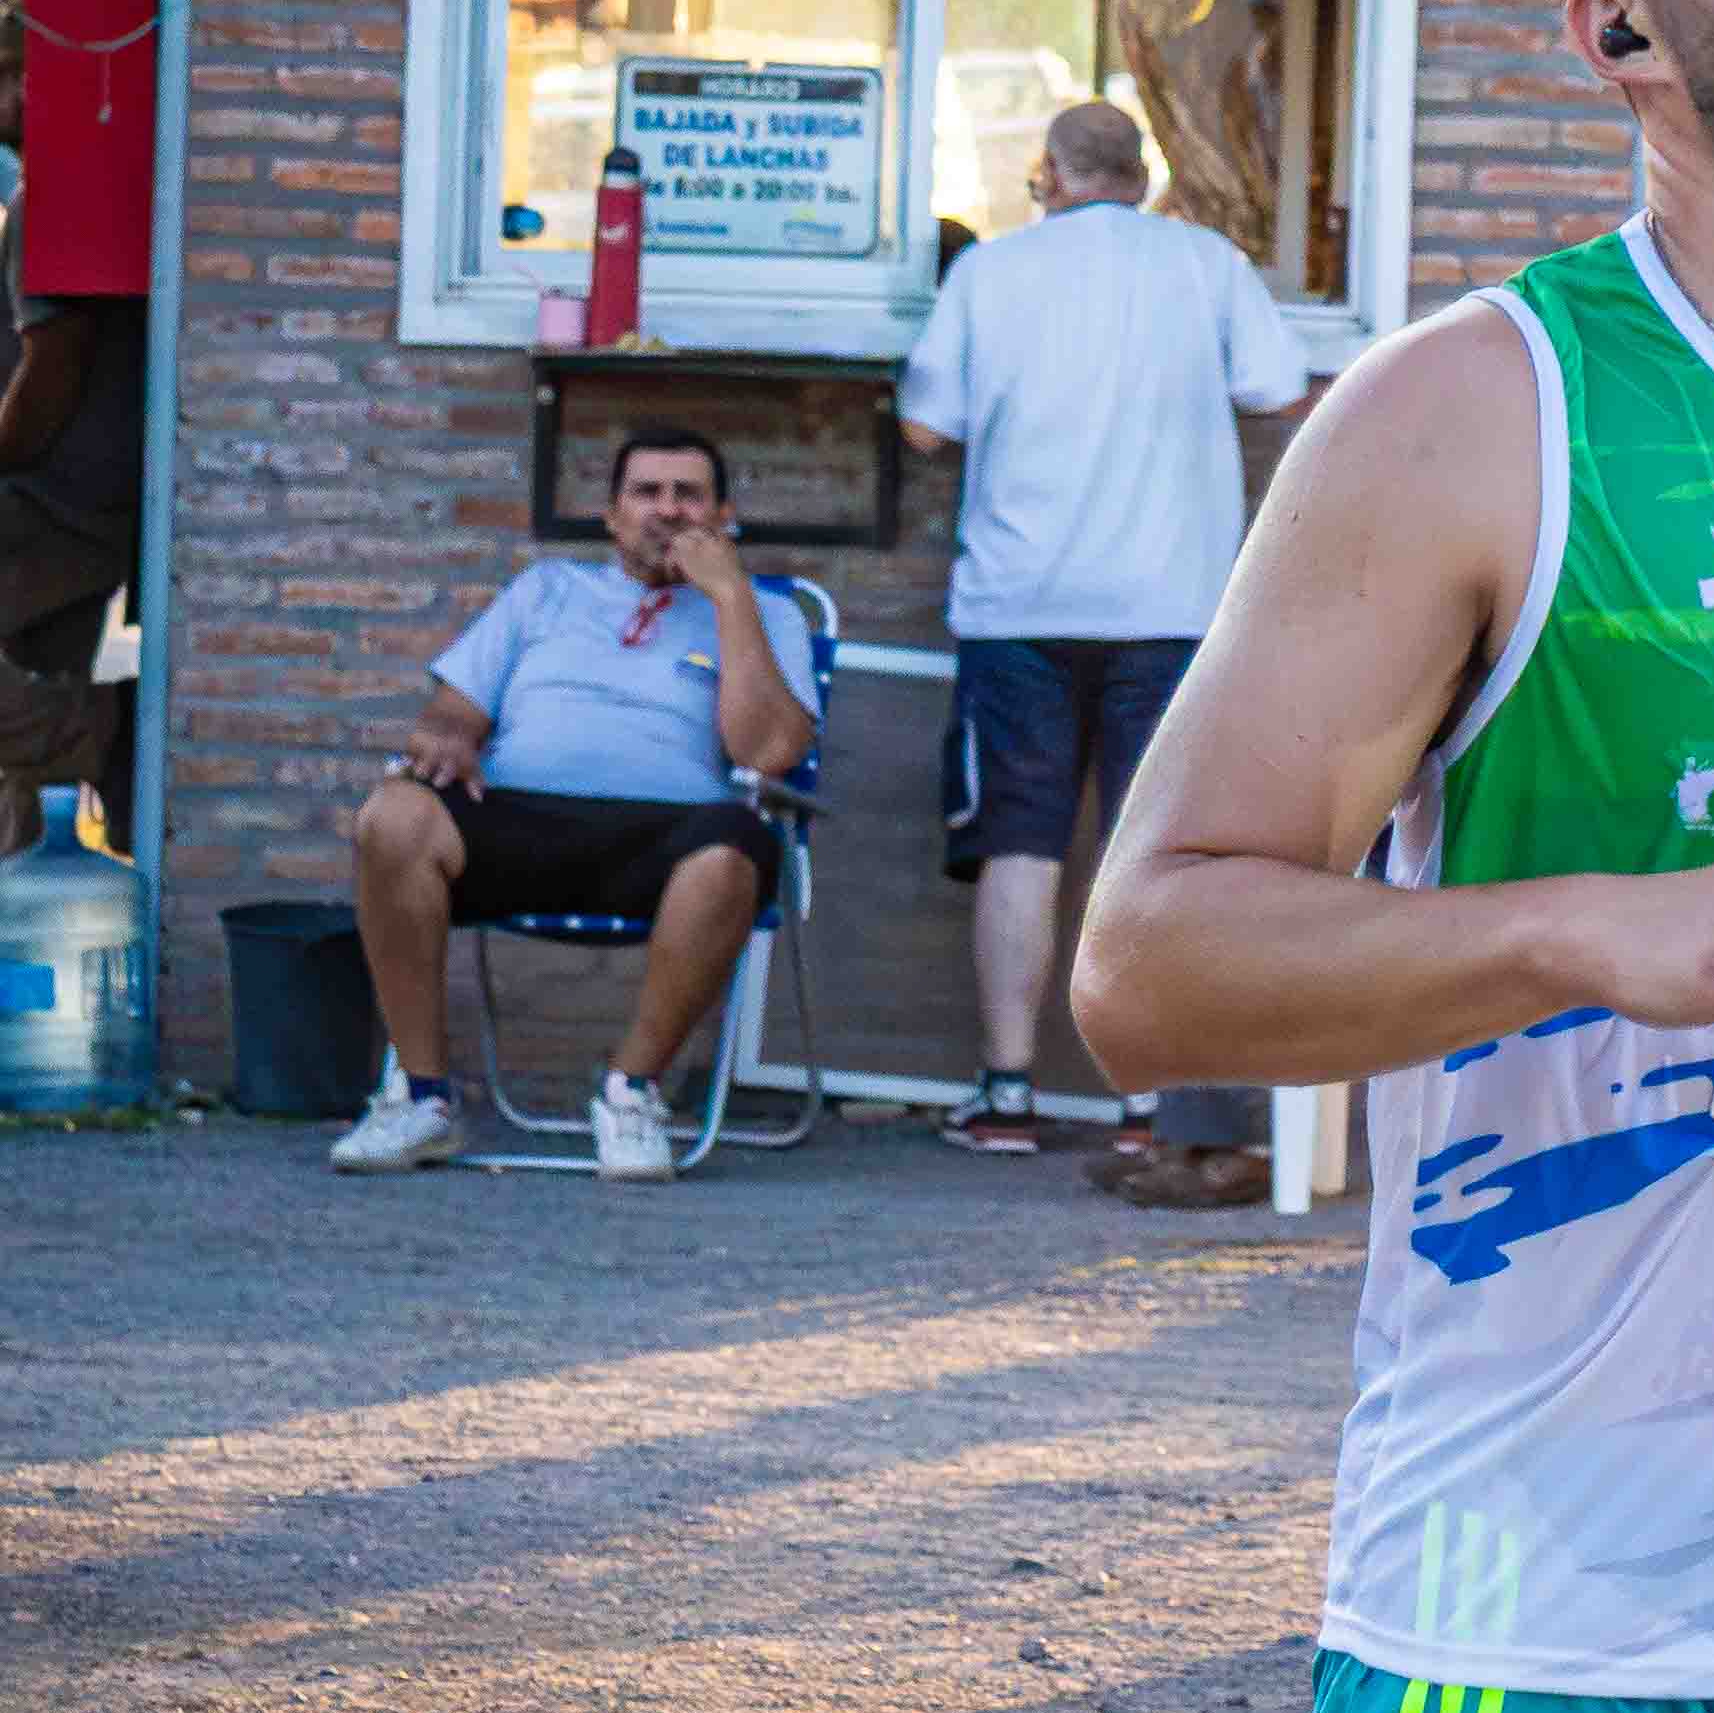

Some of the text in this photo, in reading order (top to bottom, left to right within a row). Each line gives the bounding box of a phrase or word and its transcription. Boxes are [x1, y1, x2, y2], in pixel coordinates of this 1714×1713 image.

[633, 109, 863, 140] BAJADA y SUBIDA
[662, 143, 829, 171] DE LANCHAS
